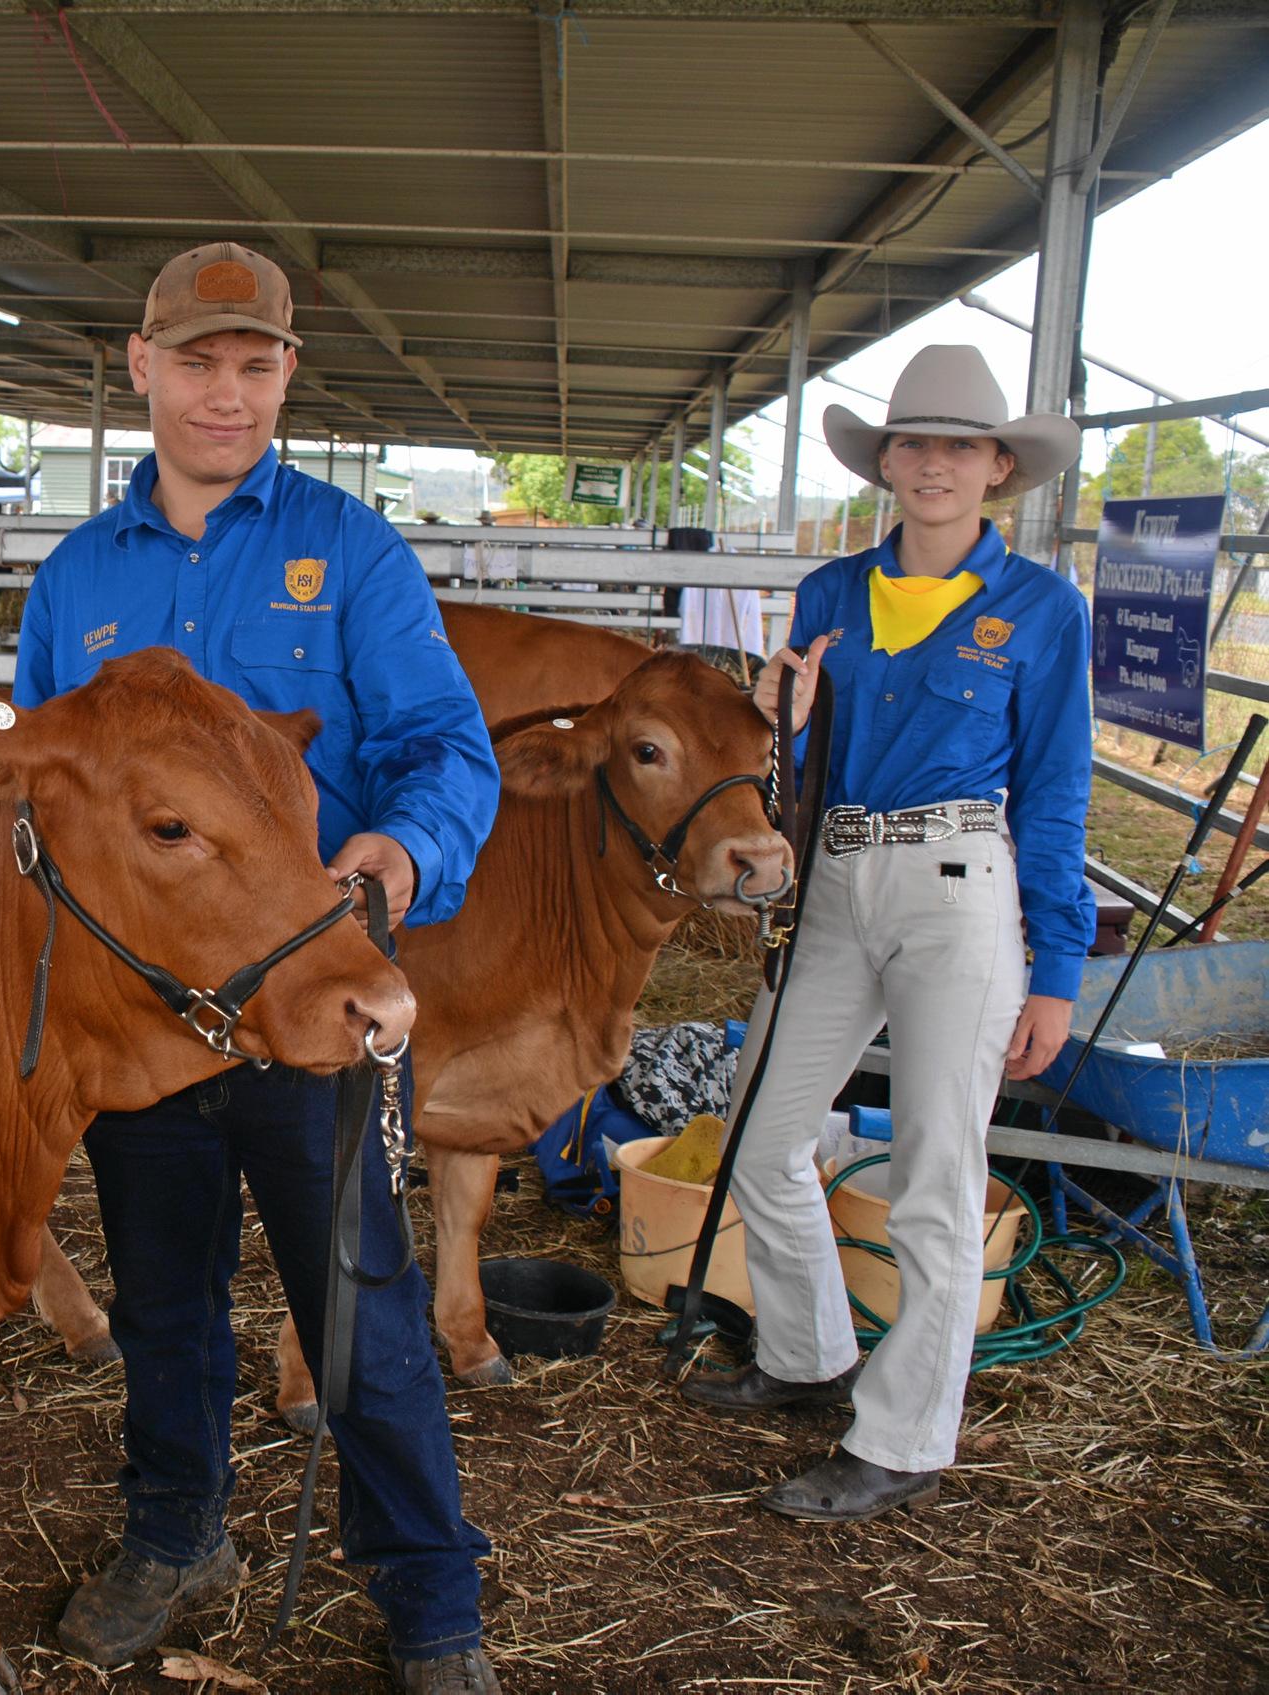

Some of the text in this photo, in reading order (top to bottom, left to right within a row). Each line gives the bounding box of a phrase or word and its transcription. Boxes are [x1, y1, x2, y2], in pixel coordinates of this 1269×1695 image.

[1131, 509, 1179, 544] KEWPIE
[1098, 556, 1163, 594] STOCKFEEDS
[1163, 568, 1183, 601] Pty.
[1124, 609, 1150, 632] Kewpie
[83, 622, 119, 648] KEWPIE
[957, 651, 1004, 669] SHOW TEAM
